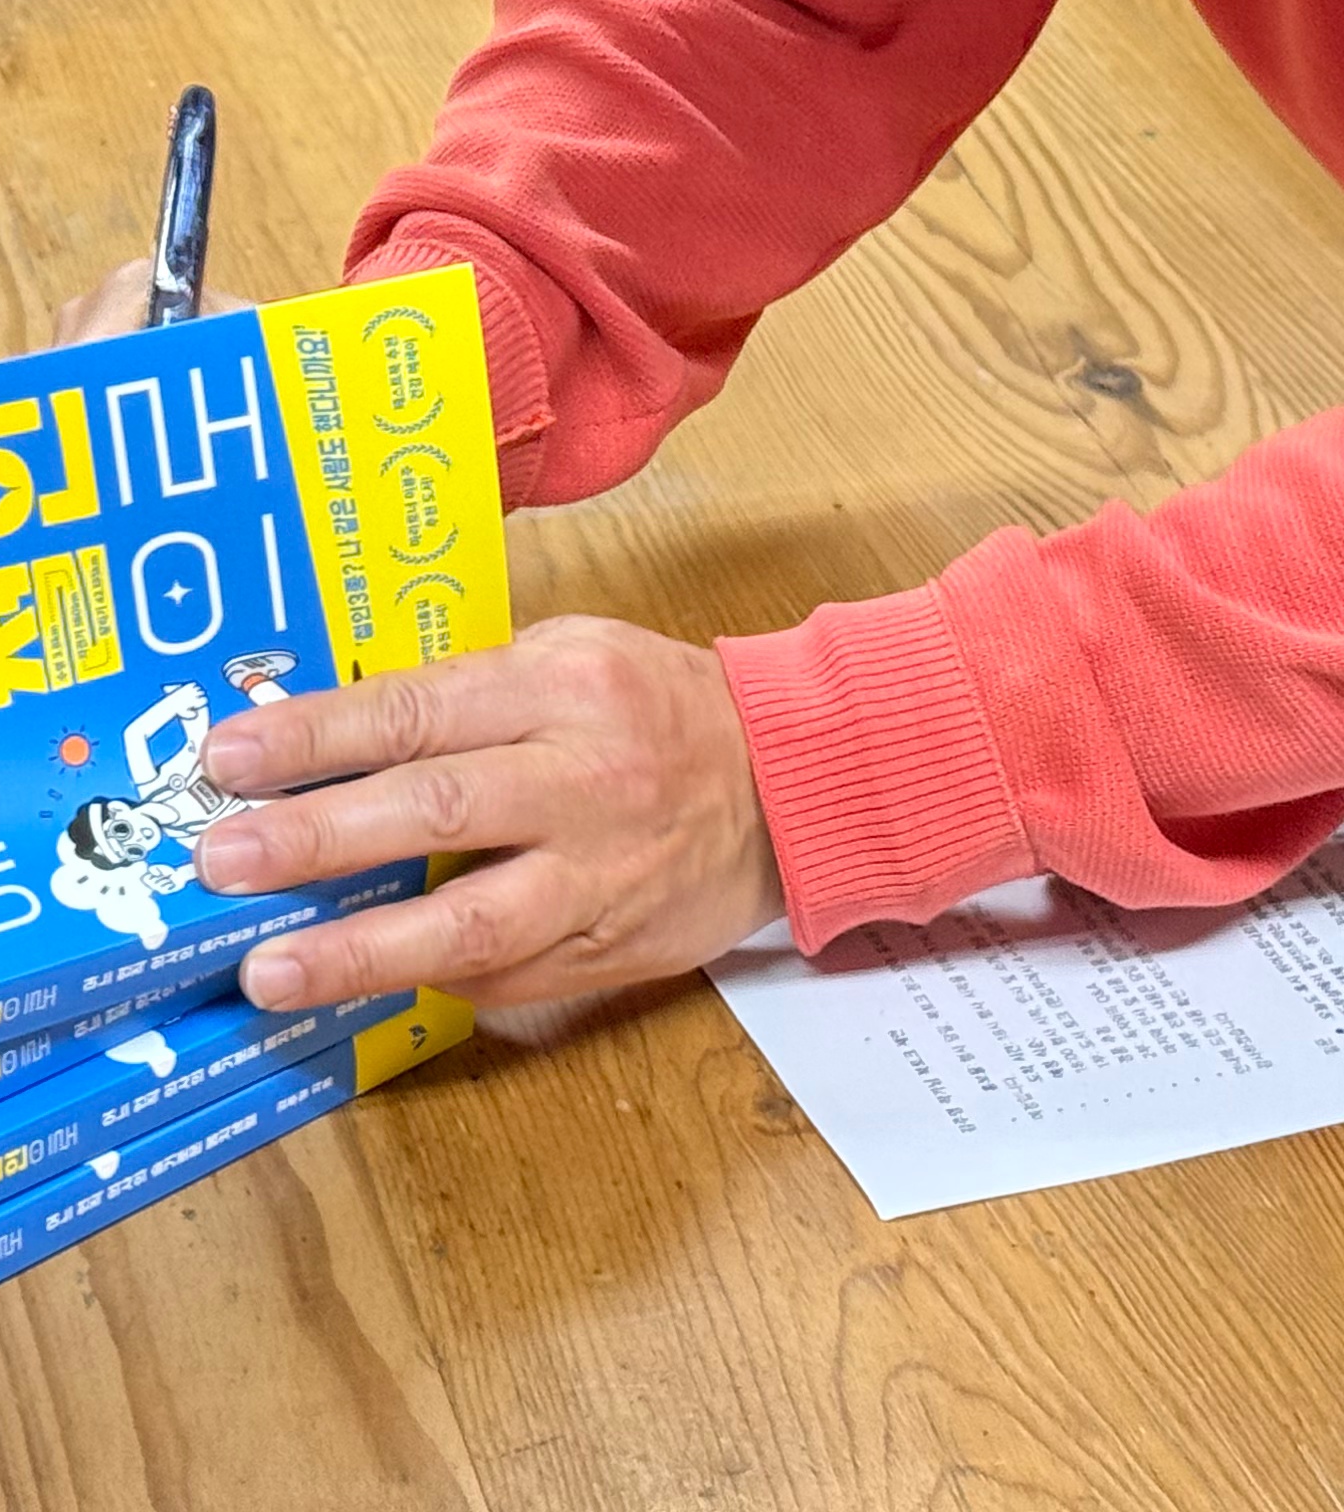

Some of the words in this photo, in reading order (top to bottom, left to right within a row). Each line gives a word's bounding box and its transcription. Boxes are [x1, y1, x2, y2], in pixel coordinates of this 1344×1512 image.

[318, 437, 352, 492] 사람도
[105, 355, 289, 657] 으로
[329, 498, 359, 535] 같은
[337, 539, 362, 559] 나
